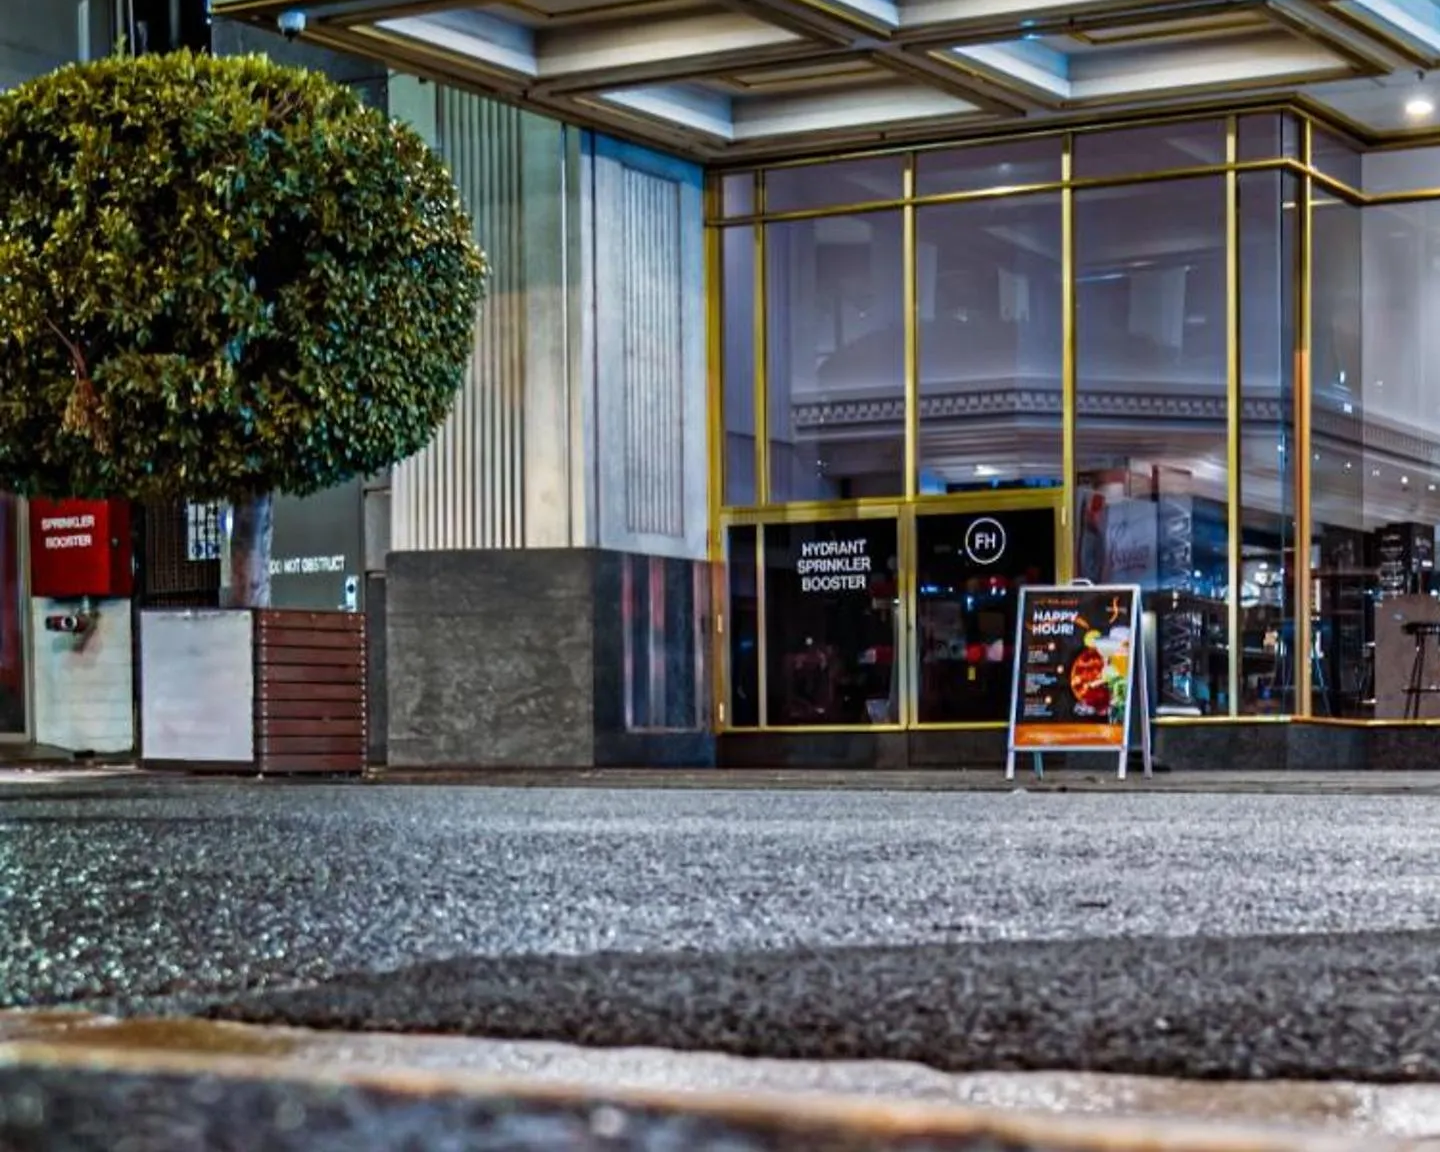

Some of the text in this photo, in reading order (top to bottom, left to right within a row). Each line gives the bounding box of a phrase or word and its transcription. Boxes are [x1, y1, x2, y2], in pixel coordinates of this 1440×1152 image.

[42, 514, 95, 531] SPRINKLER
[46, 534, 92, 548] BOOSTER
[802, 539, 866, 556] HYDRANT
[975, 532, 996, 549] FH
[284, 557, 300, 573] NOT
[301, 555, 344, 572] OBSTRUCT
[797, 555, 871, 575] SPRINKLER
[802, 574, 866, 591] BOOSTER
[1033, 609, 1079, 622] HAPPY
[1032, 622, 1075, 636] HOUR!
